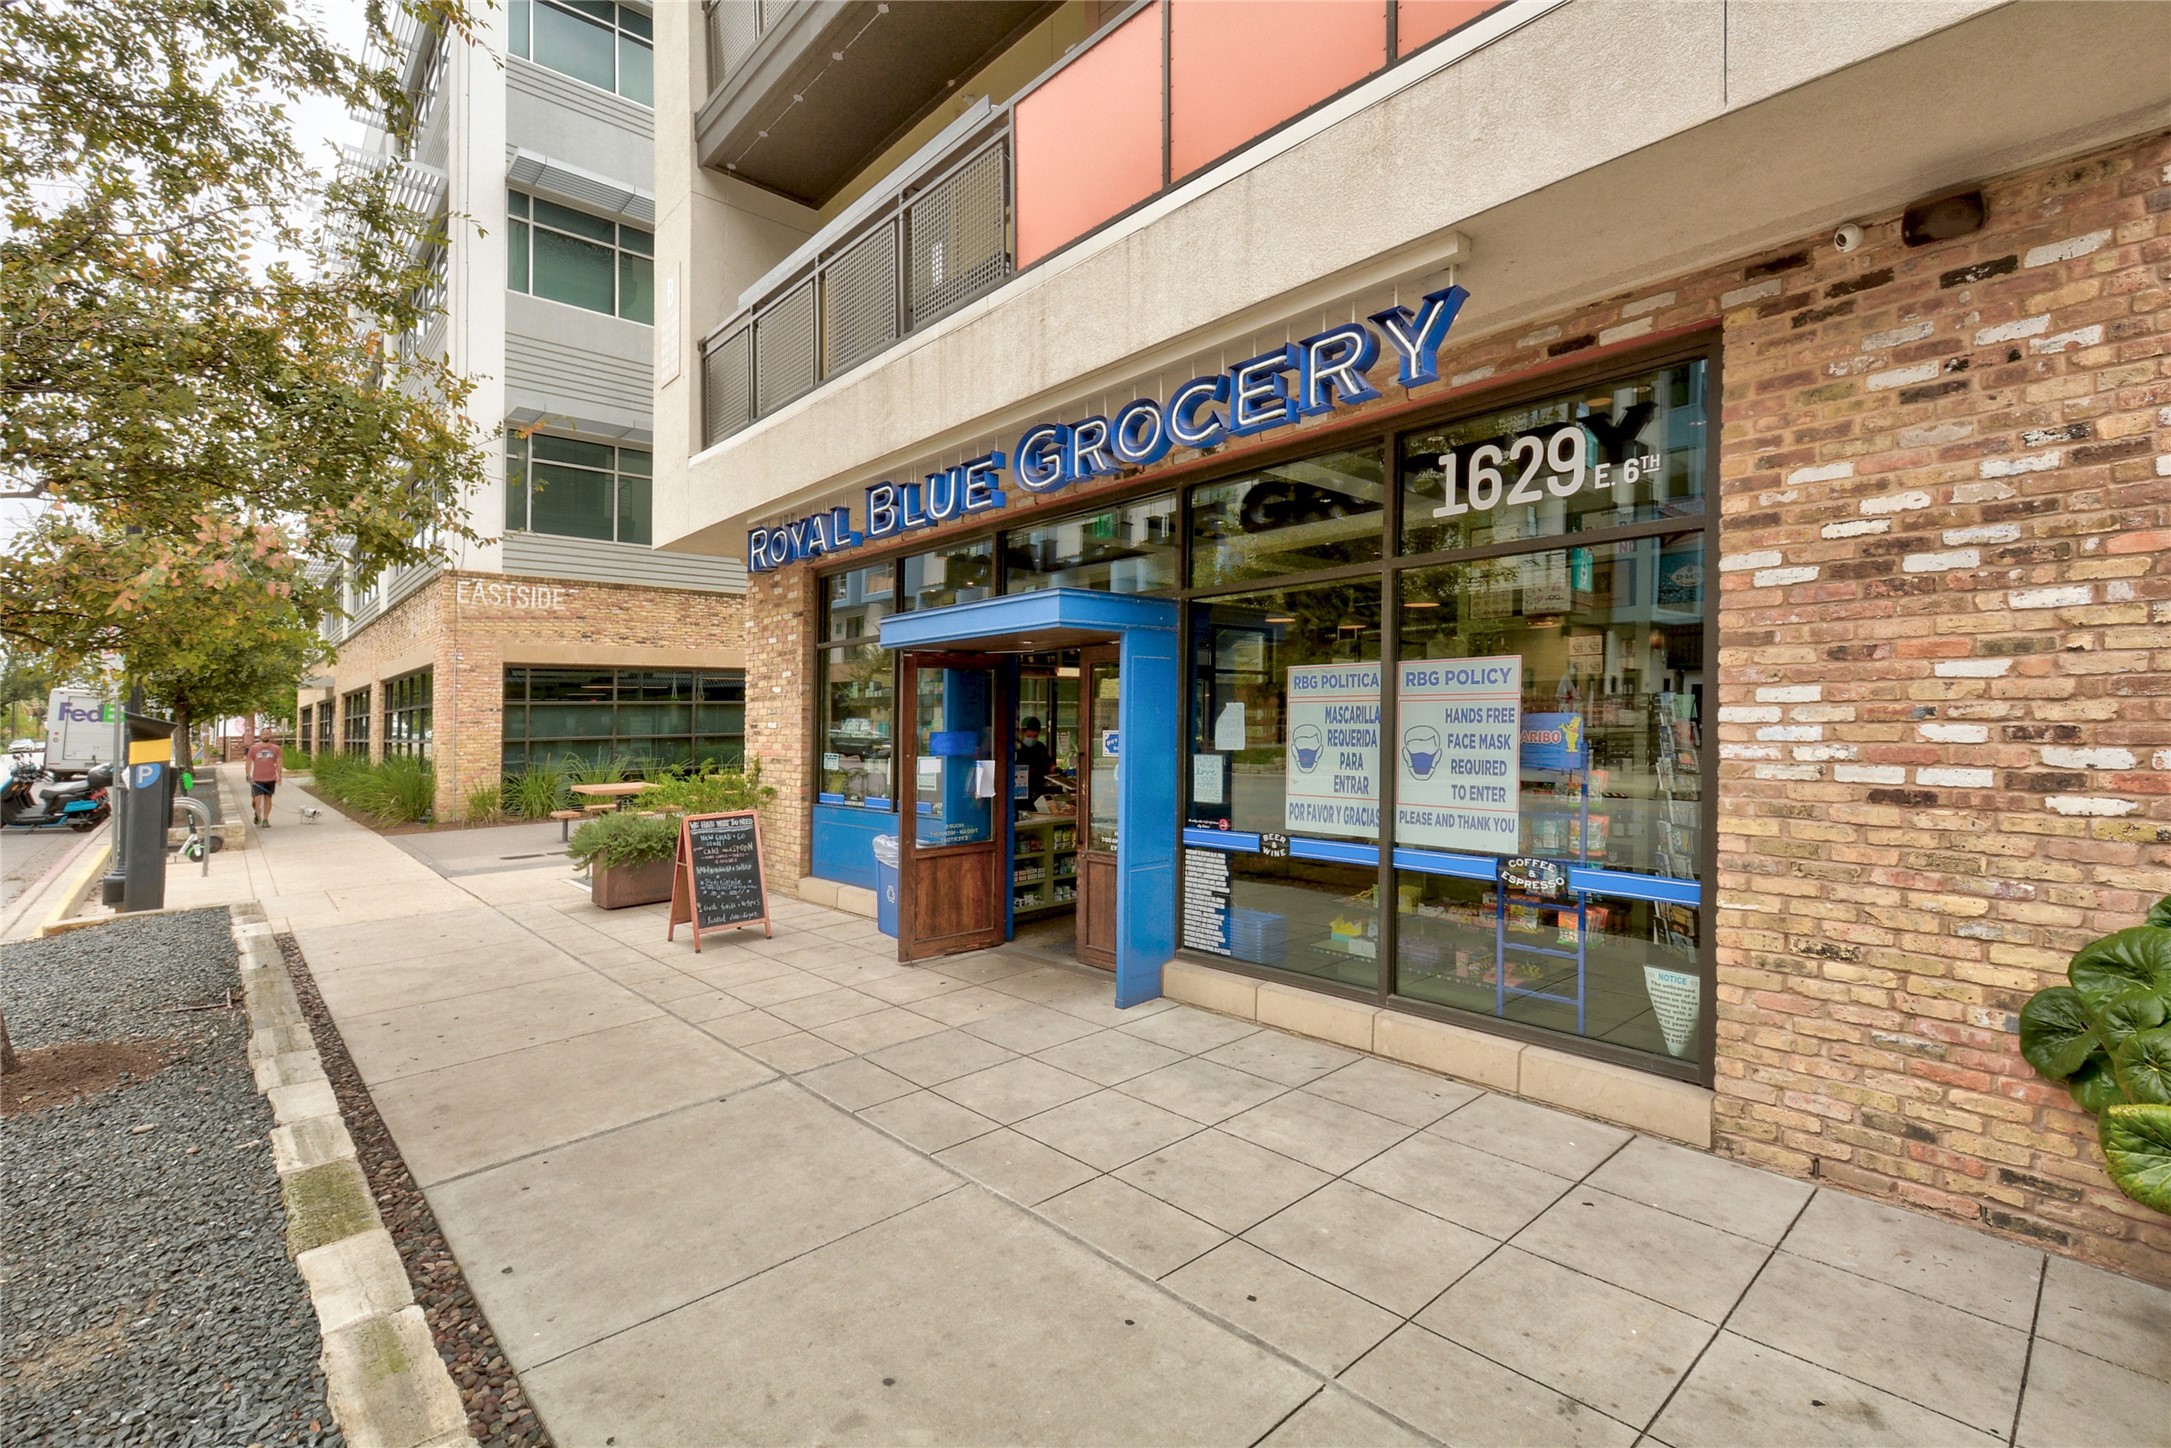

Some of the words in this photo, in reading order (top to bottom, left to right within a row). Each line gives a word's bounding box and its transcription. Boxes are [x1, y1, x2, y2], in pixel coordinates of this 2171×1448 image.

[747, 505, 863, 572] ROYAL
[865, 450, 1006, 540] BLUE
[1013, 284, 1470, 493] GROCERY
[1433, 426, 1586, 518] 1629
[1595, 463, 1616, 489] E.
[1623, 453, 1660, 483] 6TH
[457, 580, 566, 610] EASTSIDE
[1294, 675, 1318, 689] RBG
[1321, 673, 1379, 688] POLITICA
[1405, 671, 1439, 687] RBG
[1445, 668, 1512, 685] POLICY
[58, 702, 125, 723] FedE
[1325, 705, 1380, 724] MASCARILLA
[1445, 708, 1482, 723] HANDS
[1486, 708, 1515, 723] FREE
[1327, 729, 1377, 748] REQUERIDA
[1447, 733, 1475, 749] FACE
[1479, 734, 1511, 749] MASK
[1520, 731, 1562, 744] ARIBO
[1340, 752, 1363, 770] PARA
[1450, 758, 1507, 776] REQUIRED
[138, 766, 153, 783] P
[1334, 775, 1368, 794] ENTRAR
[1451, 784, 1466, 800] TO
[1469, 785, 1506, 803] ENTER
[1289, 802, 1305, 821] POR
[1306, 803, 1334, 823] FAVOR
[1336, 806, 1341, 824] Y
[1399, 810, 1432, 826] PLEASE
[1434, 813, 1455, 827] AND
[1457, 814, 1490, 831] THANK
[1493, 817, 1515, 833] YOU
[1262, 833, 1286, 844] BEER
[1262, 846, 1286, 857] WINE
[1508, 858, 1556, 872] COFFEE
[1528, 870, 1536, 878] &
[1500, 870, 1564, 890] ESPRESSO
[1658, 973, 1687, 985] NOTICE
